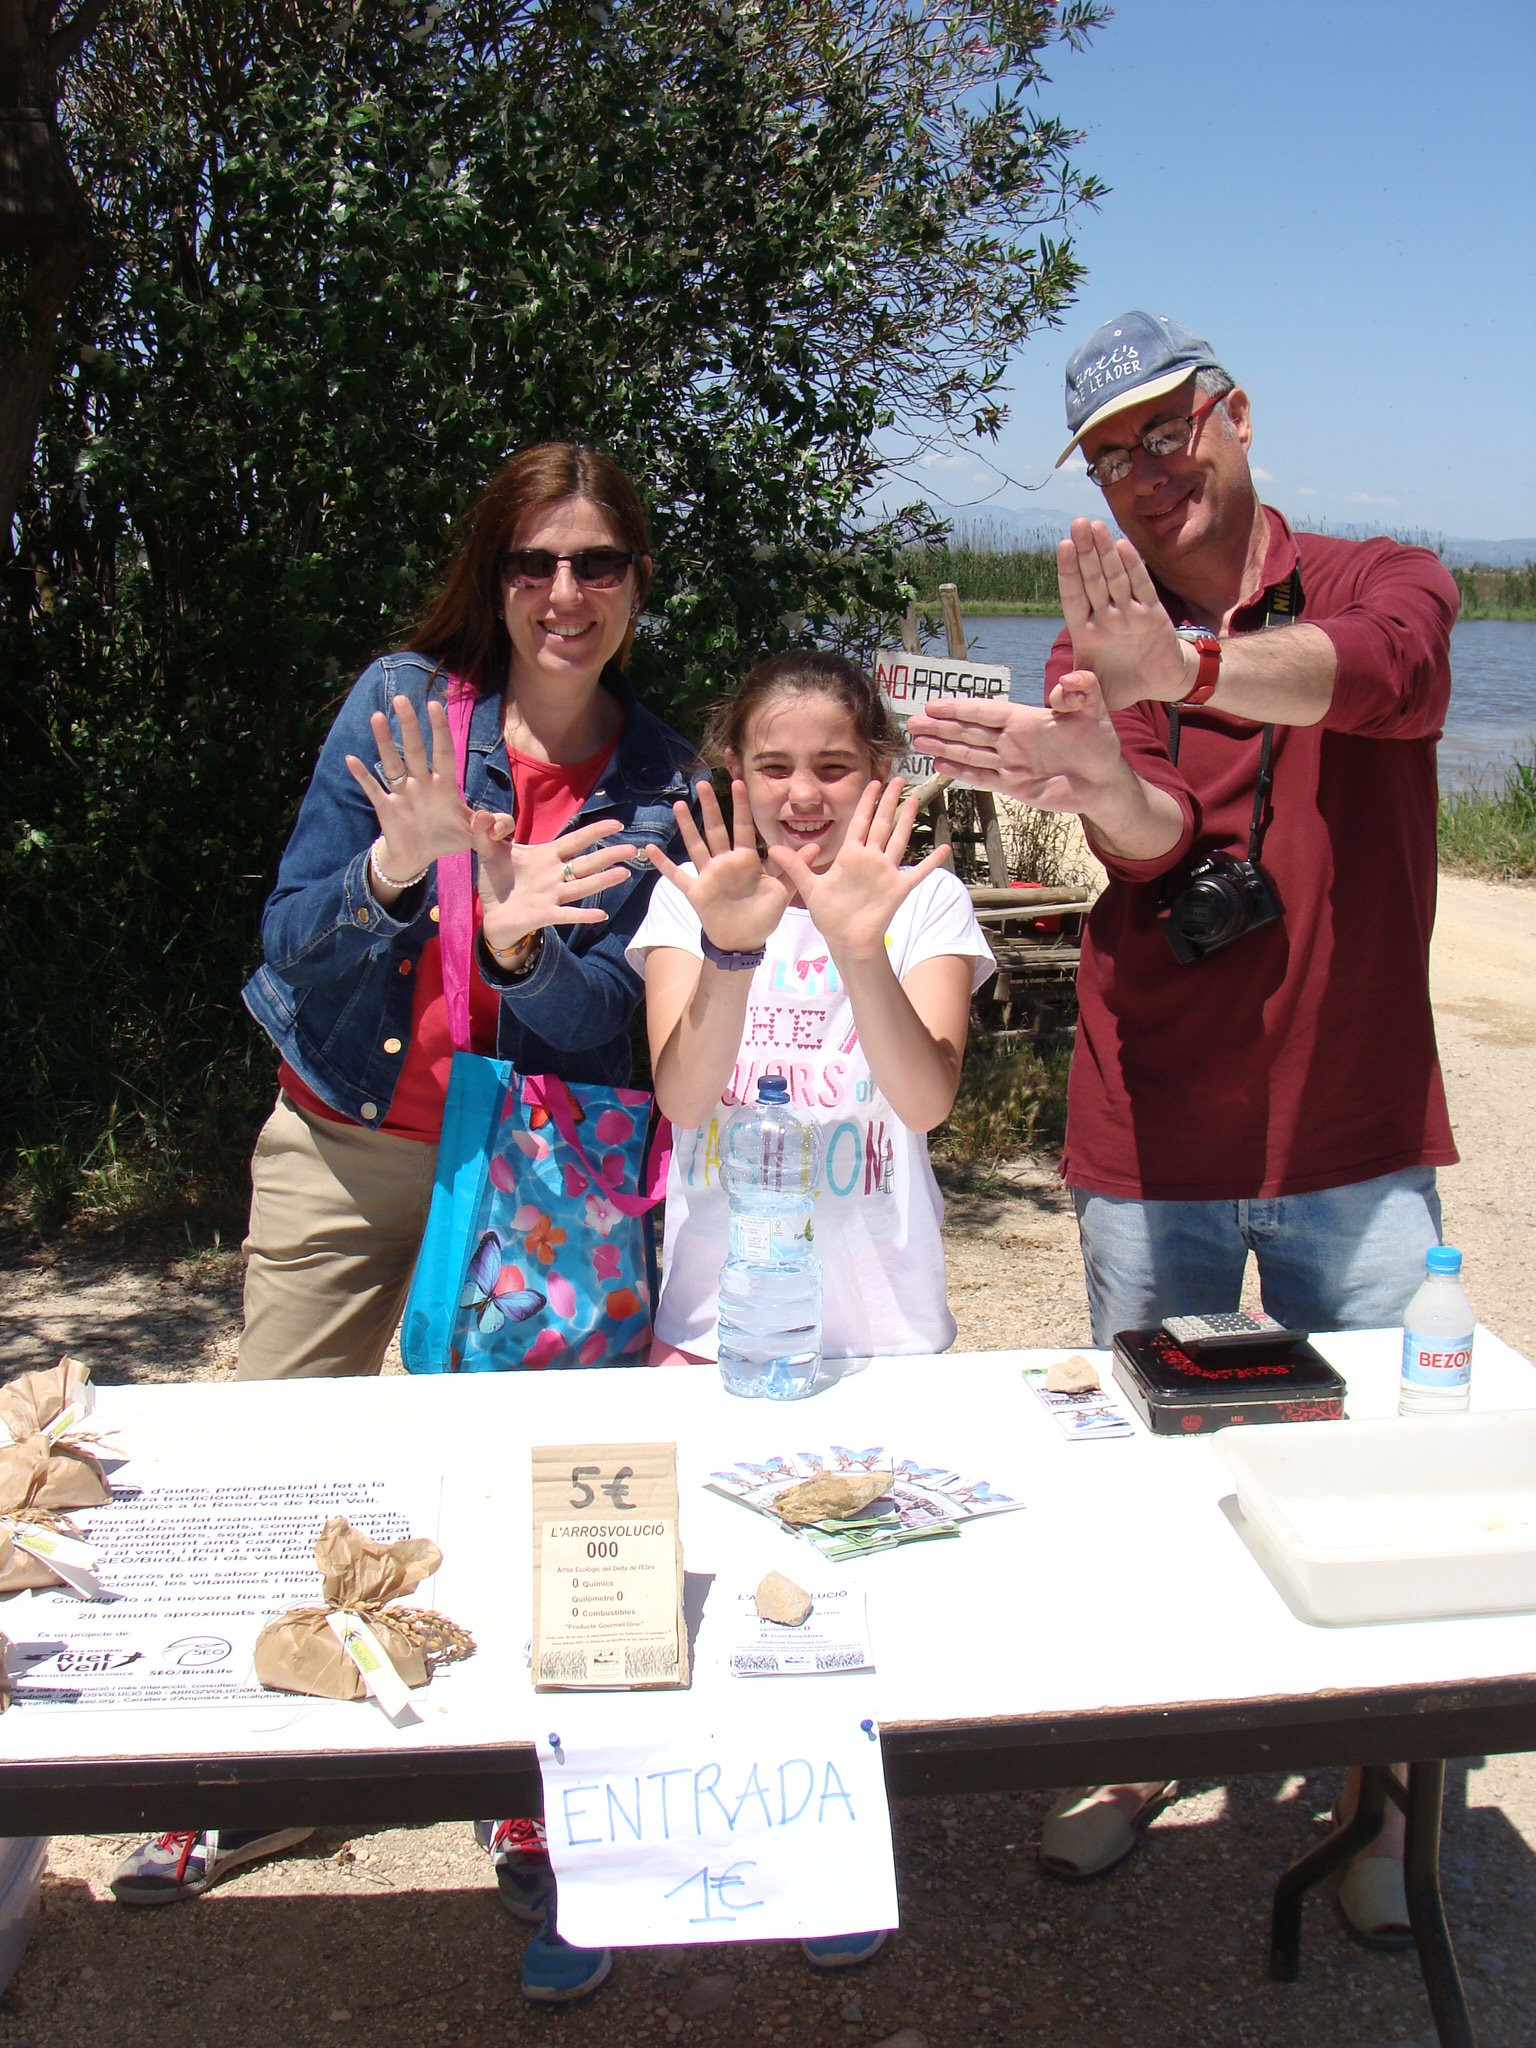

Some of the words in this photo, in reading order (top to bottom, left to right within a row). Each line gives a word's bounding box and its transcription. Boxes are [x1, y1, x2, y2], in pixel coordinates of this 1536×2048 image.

[1090, 360, 1143, 394] LEADER
[1273, 575, 1291, 613] Nik
[877, 662, 909, 701] NO
[745, 1006, 826, 1050] HE
[721, 1058, 848, 1108] OLRS
[150, 1487, 210, 1495] d'autor,
[215, 1483, 318, 1494] preindustrial
[569, 1465, 637, 1511] 5€
[163, 1493, 253, 1502] tradicional,
[258, 1490, 358, 1500] participativa
[87, 1518, 146, 1526] Plantat
[216, 1514, 319, 1522] manualment
[115, 1532, 210, 1541] protegides,
[216, 1530, 263, 1540] segat
[268, 1529, 304, 1537] amb
[369, 1526, 411, 1535] picat
[125, 1525, 176, 1533] adobs
[550, 1521, 665, 1538] L'ARROSVOLUCIÓ
[94, 1539, 198, 1548] tesanalment
[203, 1538, 240, 1546] amb
[245, 1536, 302, 1545] cadup,
[114, 1548, 129, 1556] al
[135, 1548, 176, 1556] vent,
[192, 1546, 225, 1554] triat
[586, 1541, 619, 1559] 000
[96, 1555, 208, 1565] SEO/BirdLife
[223, 1554, 248, 1562] els
[254, 1552, 317, 1561] visitant
[123, 1572, 164, 1580] arròs
[170, 1571, 184, 1579] té
[263, 1569, 322, 1577] primige
[164, 1579, 187, 1587] les
[193, 1578, 269, 1586] vitamines
[572, 1577, 579, 1588] 0
[176, 1594, 231, 1602] nevera
[237, 1592, 266, 1600] fins
[572, 1594, 615, 1604] Quilòmetre
[616, 1590, 624, 1601] 0
[77, 1612, 97, 1620] 28
[101, 1611, 158, 1619] minuts
[163, 1609, 256, 1618] aproximats
[571, 1607, 579, 1617] 0
[582, 1608, 636, 1617] Combustibles
[70, 1631, 113, 1639] projecte
[56, 1652, 116, 1663] Riet
[56, 1662, 109, 1672] Vell
[148, 1668, 234, 1676] SEO/BirdLife
[562, 1757, 856, 1847] ENTRADA
[663, 1859, 765, 1924] 1€
